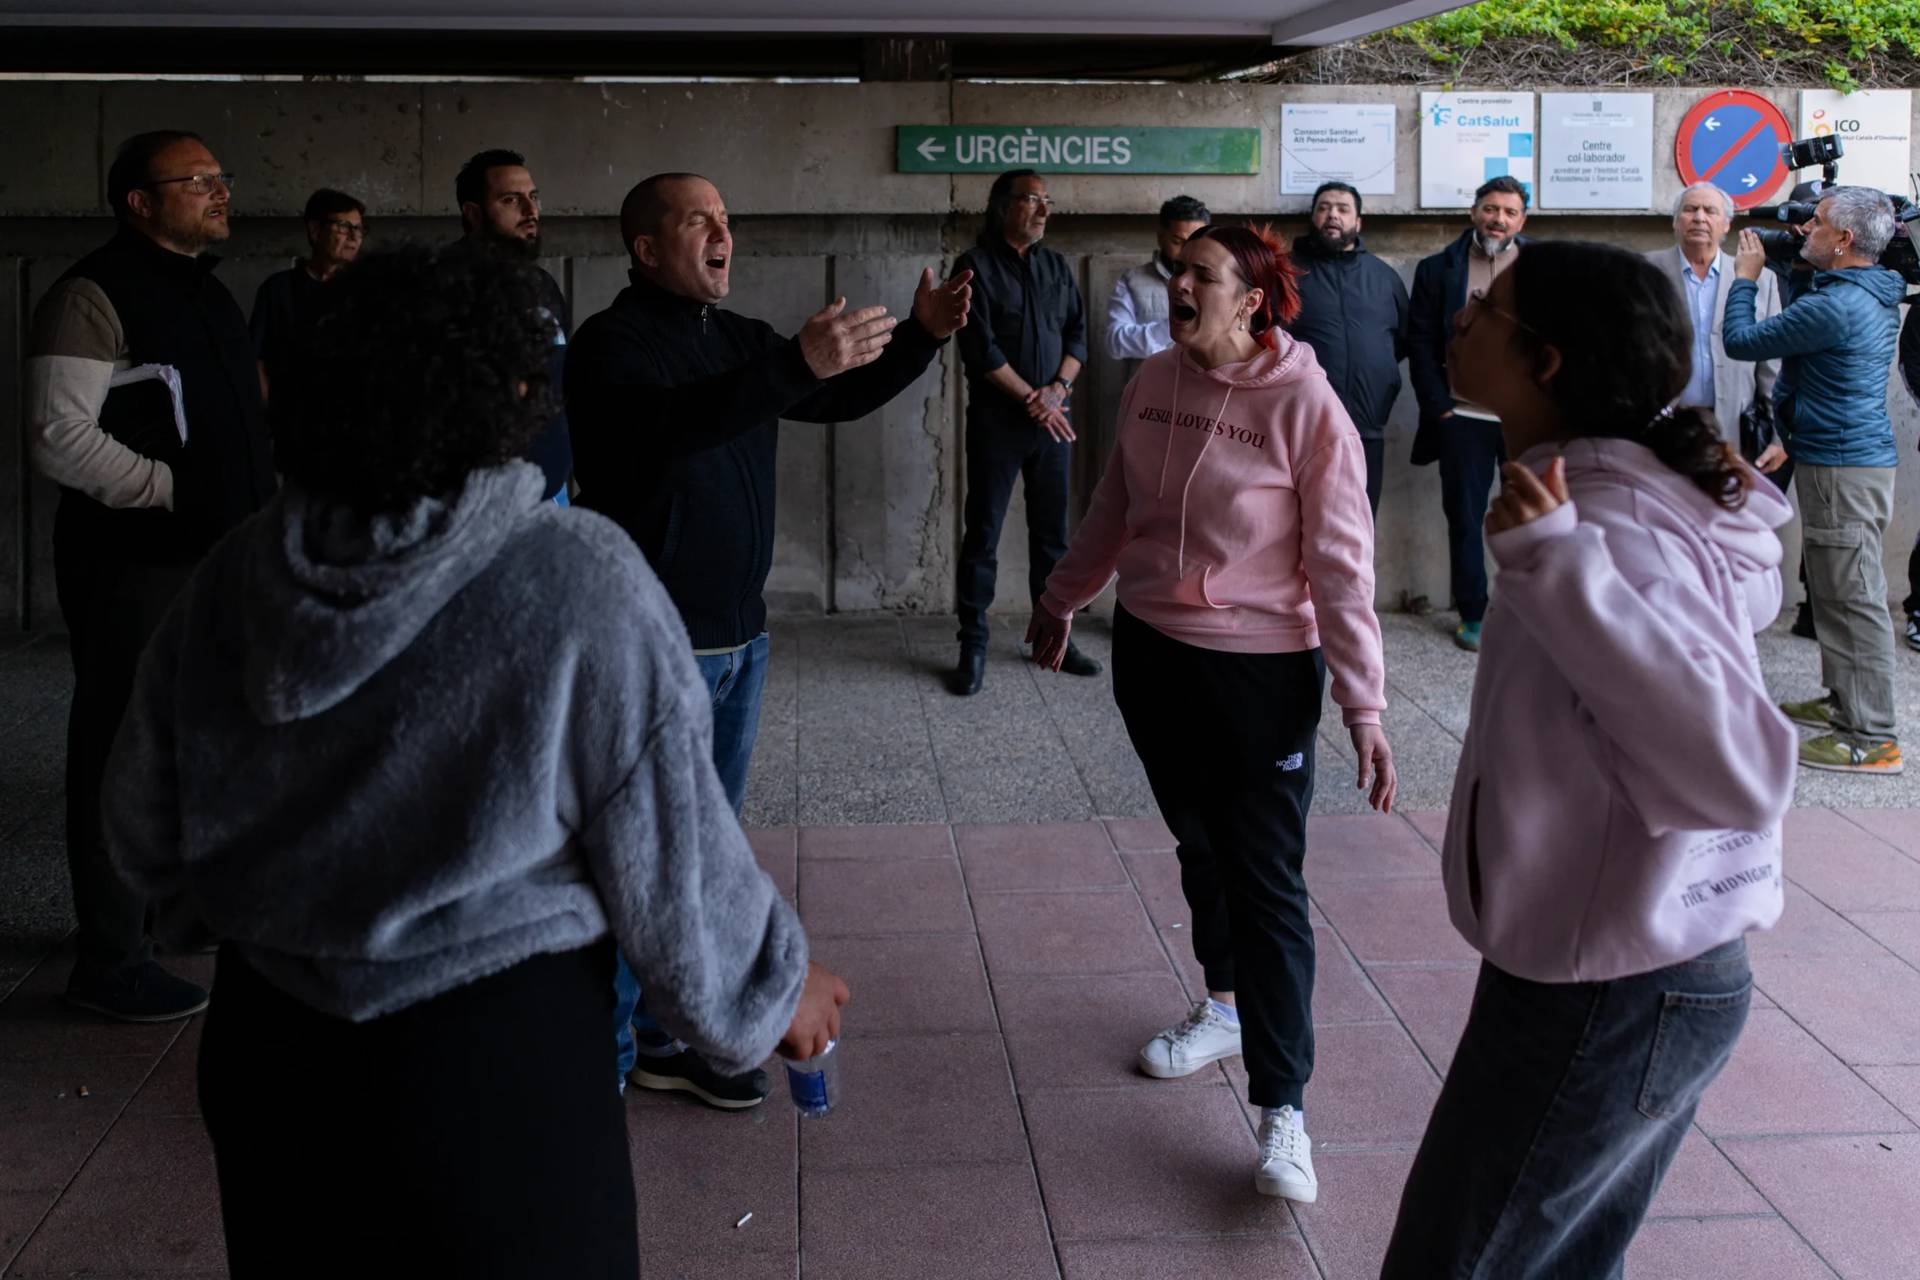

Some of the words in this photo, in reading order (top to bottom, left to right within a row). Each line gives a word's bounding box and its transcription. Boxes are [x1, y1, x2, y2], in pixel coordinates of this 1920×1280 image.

[1457, 115, 1519, 127] CatSalut
[1835, 119, 1860, 132] ICO
[956, 128, 1131, 164] URGÈNCIES
[1582, 140, 1611, 151] Centre
[1176, 412, 1226, 435] LOVES
[1228, 424, 1266, 448] YOU
[1716, 834, 1753, 854] NEED
[1681, 889, 1709, 908] THE
[1710, 864, 1772, 896] MIDNIGHT
